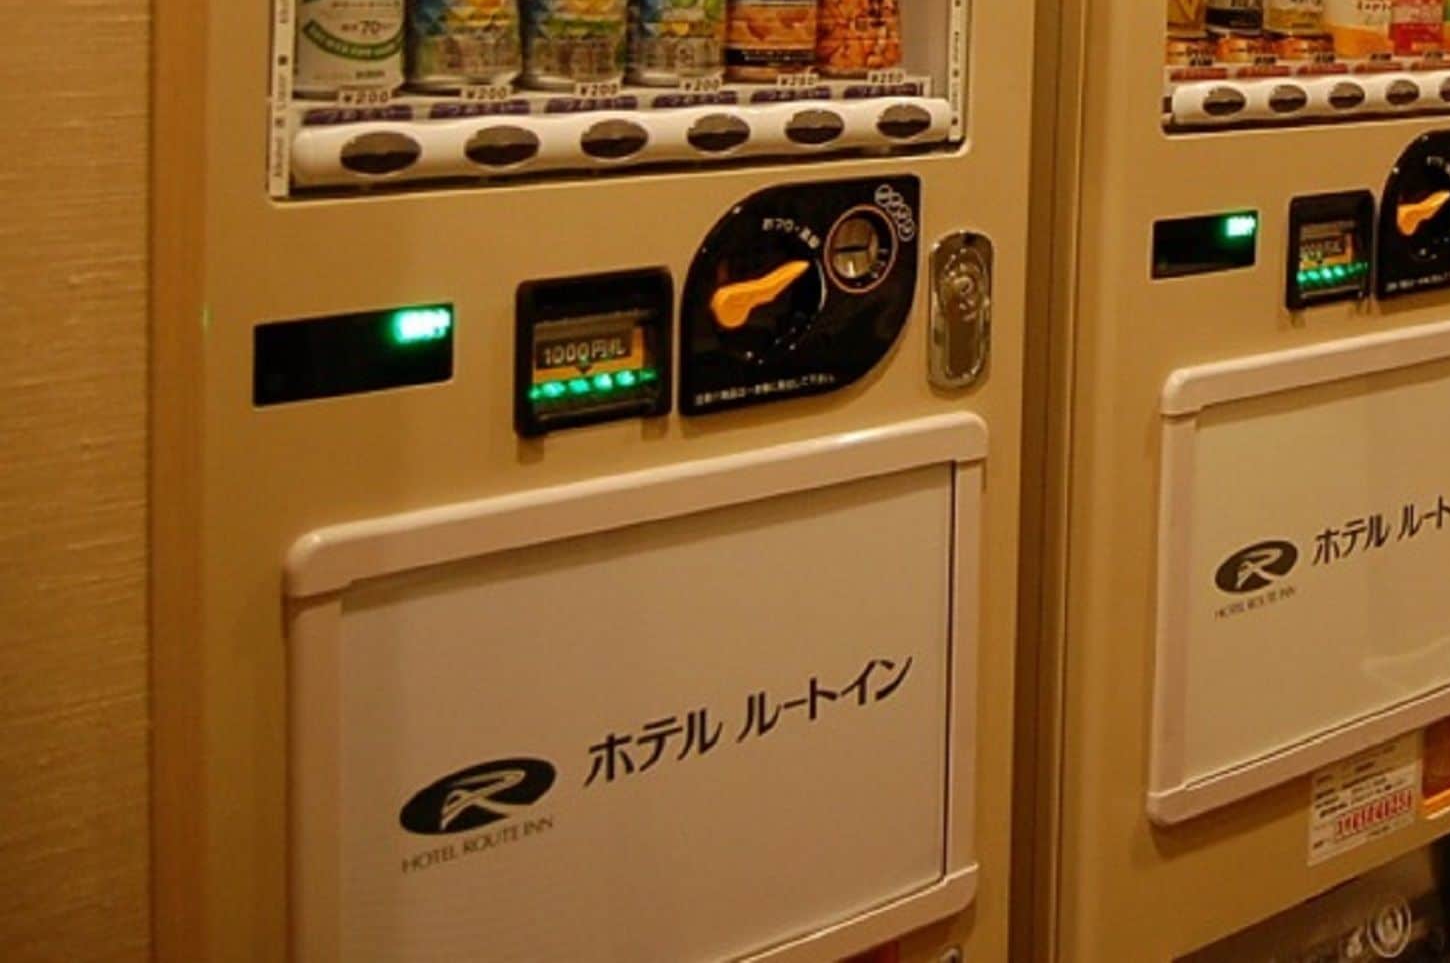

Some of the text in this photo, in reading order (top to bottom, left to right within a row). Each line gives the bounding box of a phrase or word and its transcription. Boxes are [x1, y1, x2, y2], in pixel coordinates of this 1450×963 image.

[1312, 513, 1391, 567] ホテル
[582, 655, 913, 788] ホテル ルートイン
[402, 815, 555, 874] HOTEL ROUTE INN
